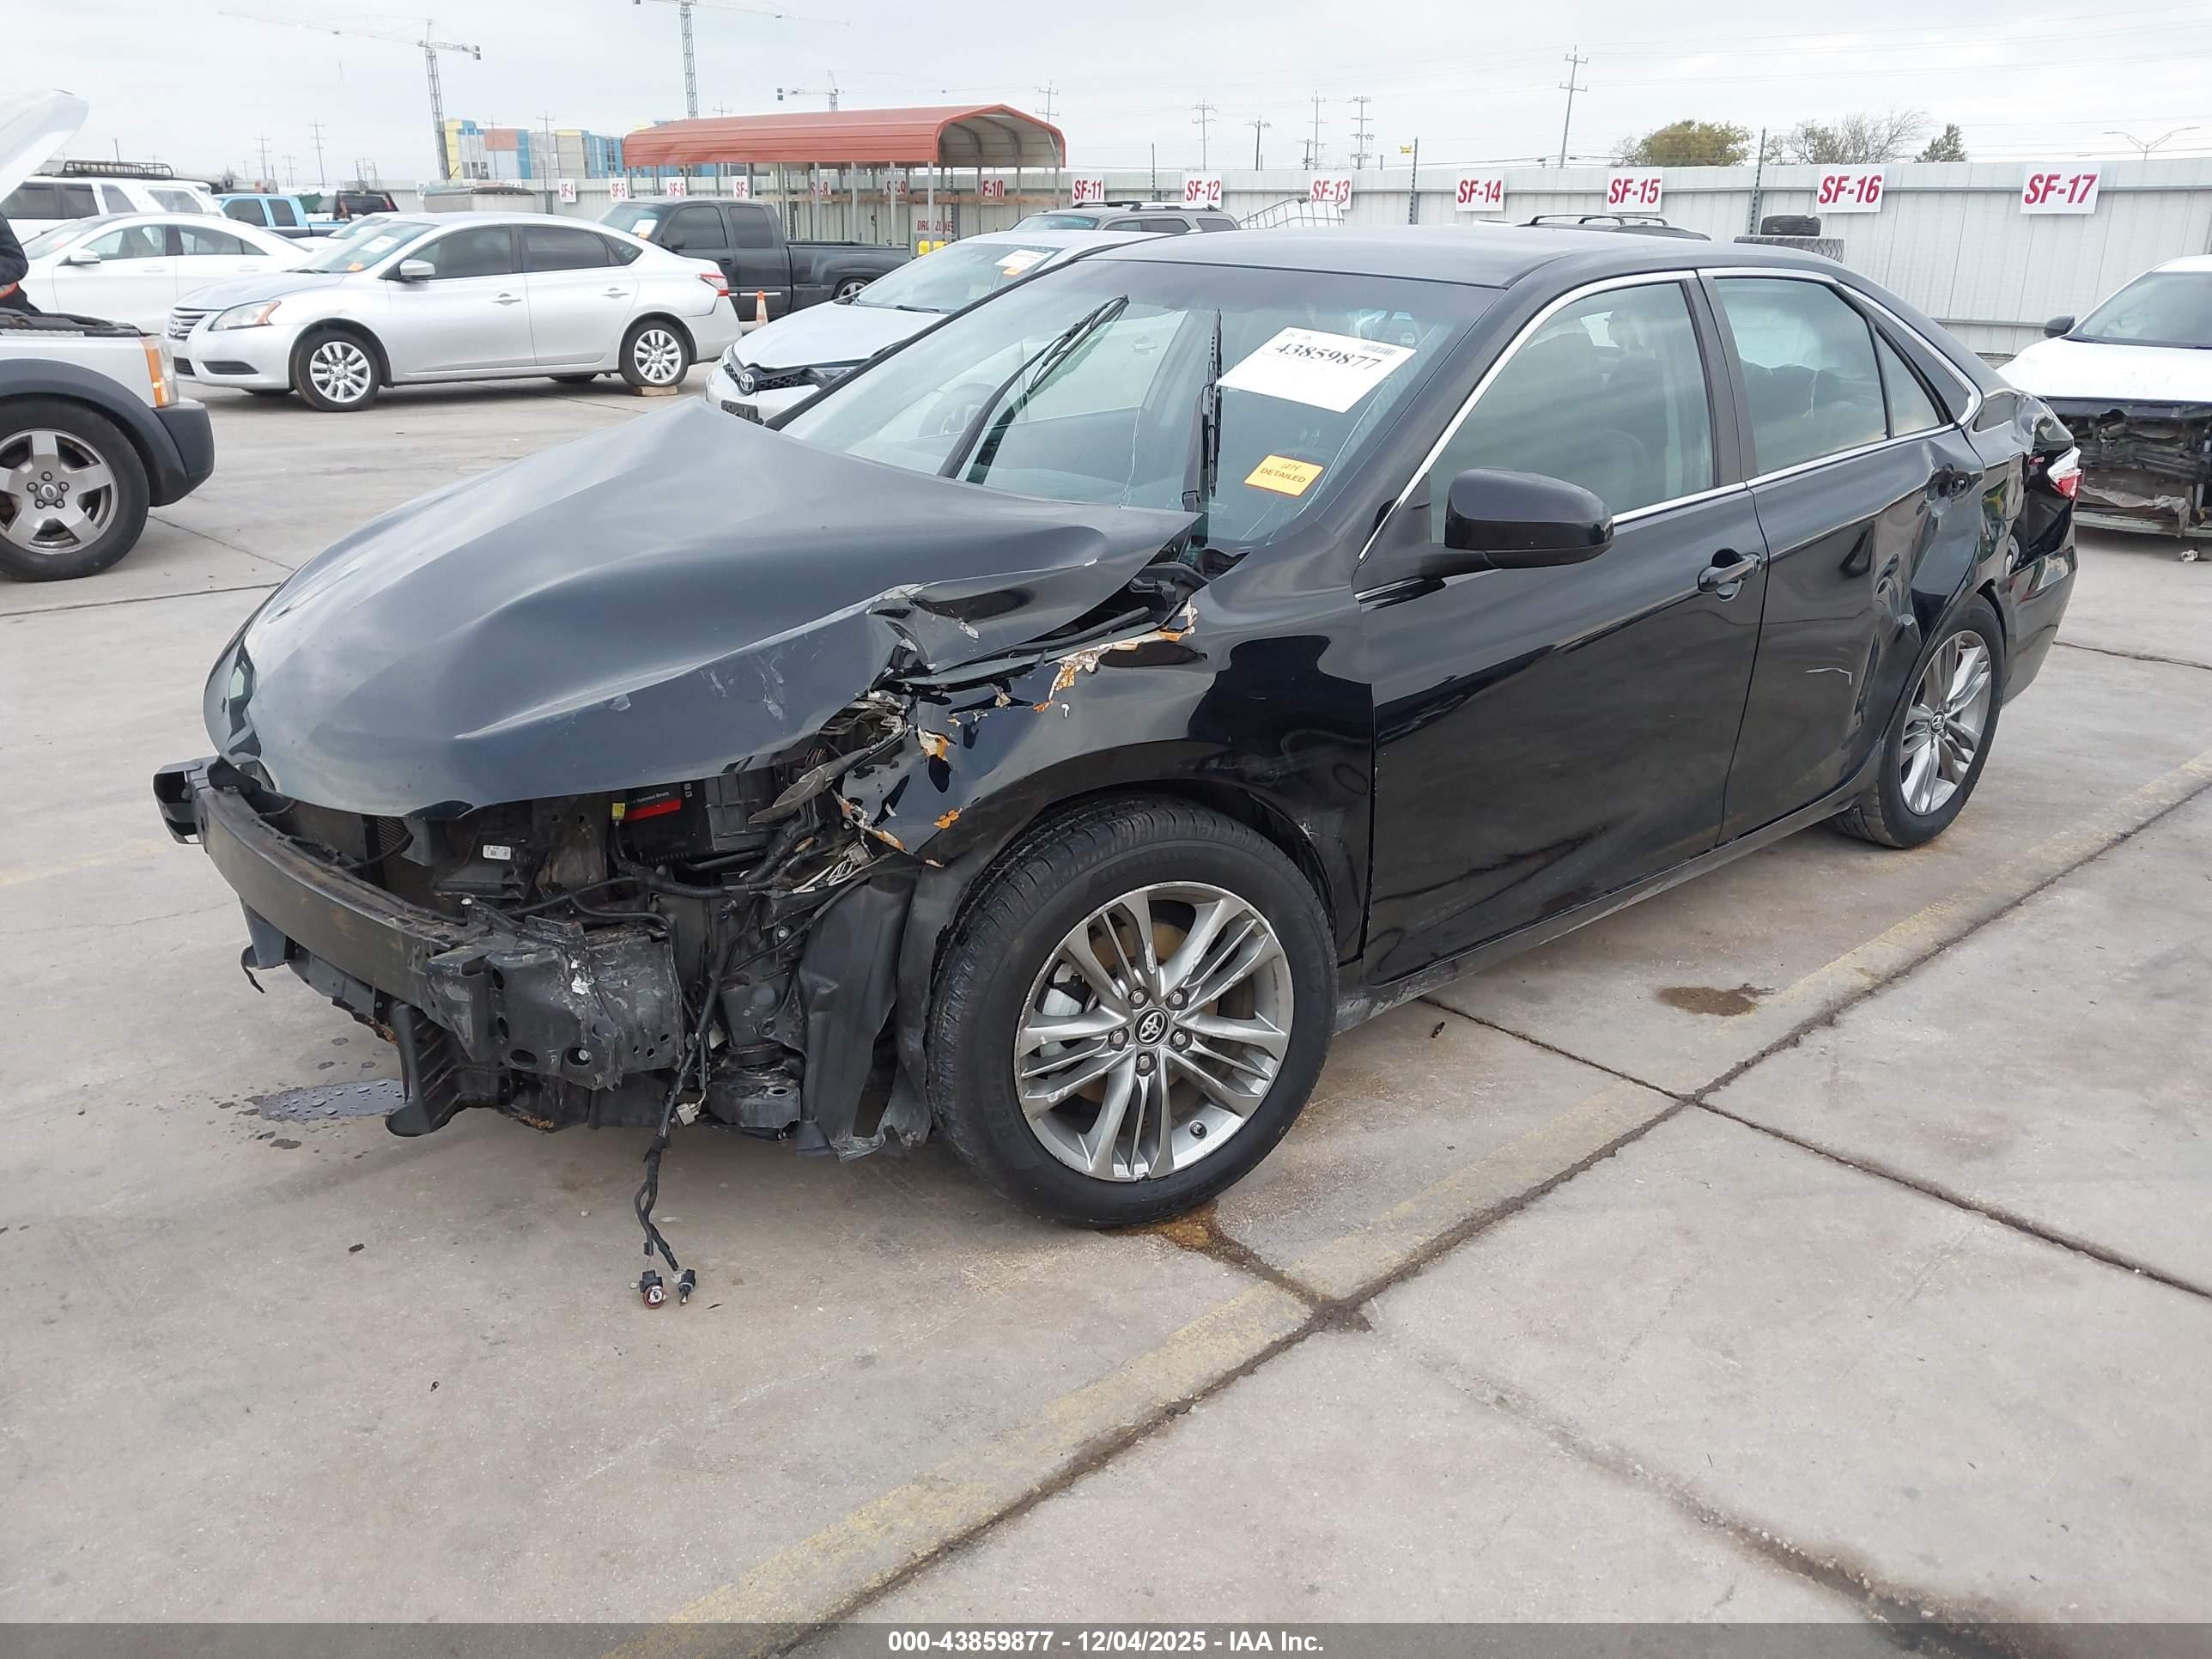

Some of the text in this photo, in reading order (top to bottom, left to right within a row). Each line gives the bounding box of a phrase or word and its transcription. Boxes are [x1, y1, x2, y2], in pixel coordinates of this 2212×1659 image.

[561, 183, 574, 198] SF-4
[611, 183, 625, 198] SF-5
[669, 183, 684, 197] SF-6
[811, 181, 829, 197] S-8
[886, 180, 906, 194] S-9
[981, 179, 1004, 197] F-10
[1074, 179, 1103, 200] SF-11
[1186, 179, 1220, 201] SF-12
[1310, 179, 1351, 203] SF-13
[1457, 179, 1502, 204] SF-14
[1608, 178, 1661, 204] SF-15
[1818, 175, 1882, 204] SF-16
[2024, 173, 2098, 204] SF-17
[1275, 343, 1383, 370] 43859877
[1260, 467, 1306, 483] DETAILED
